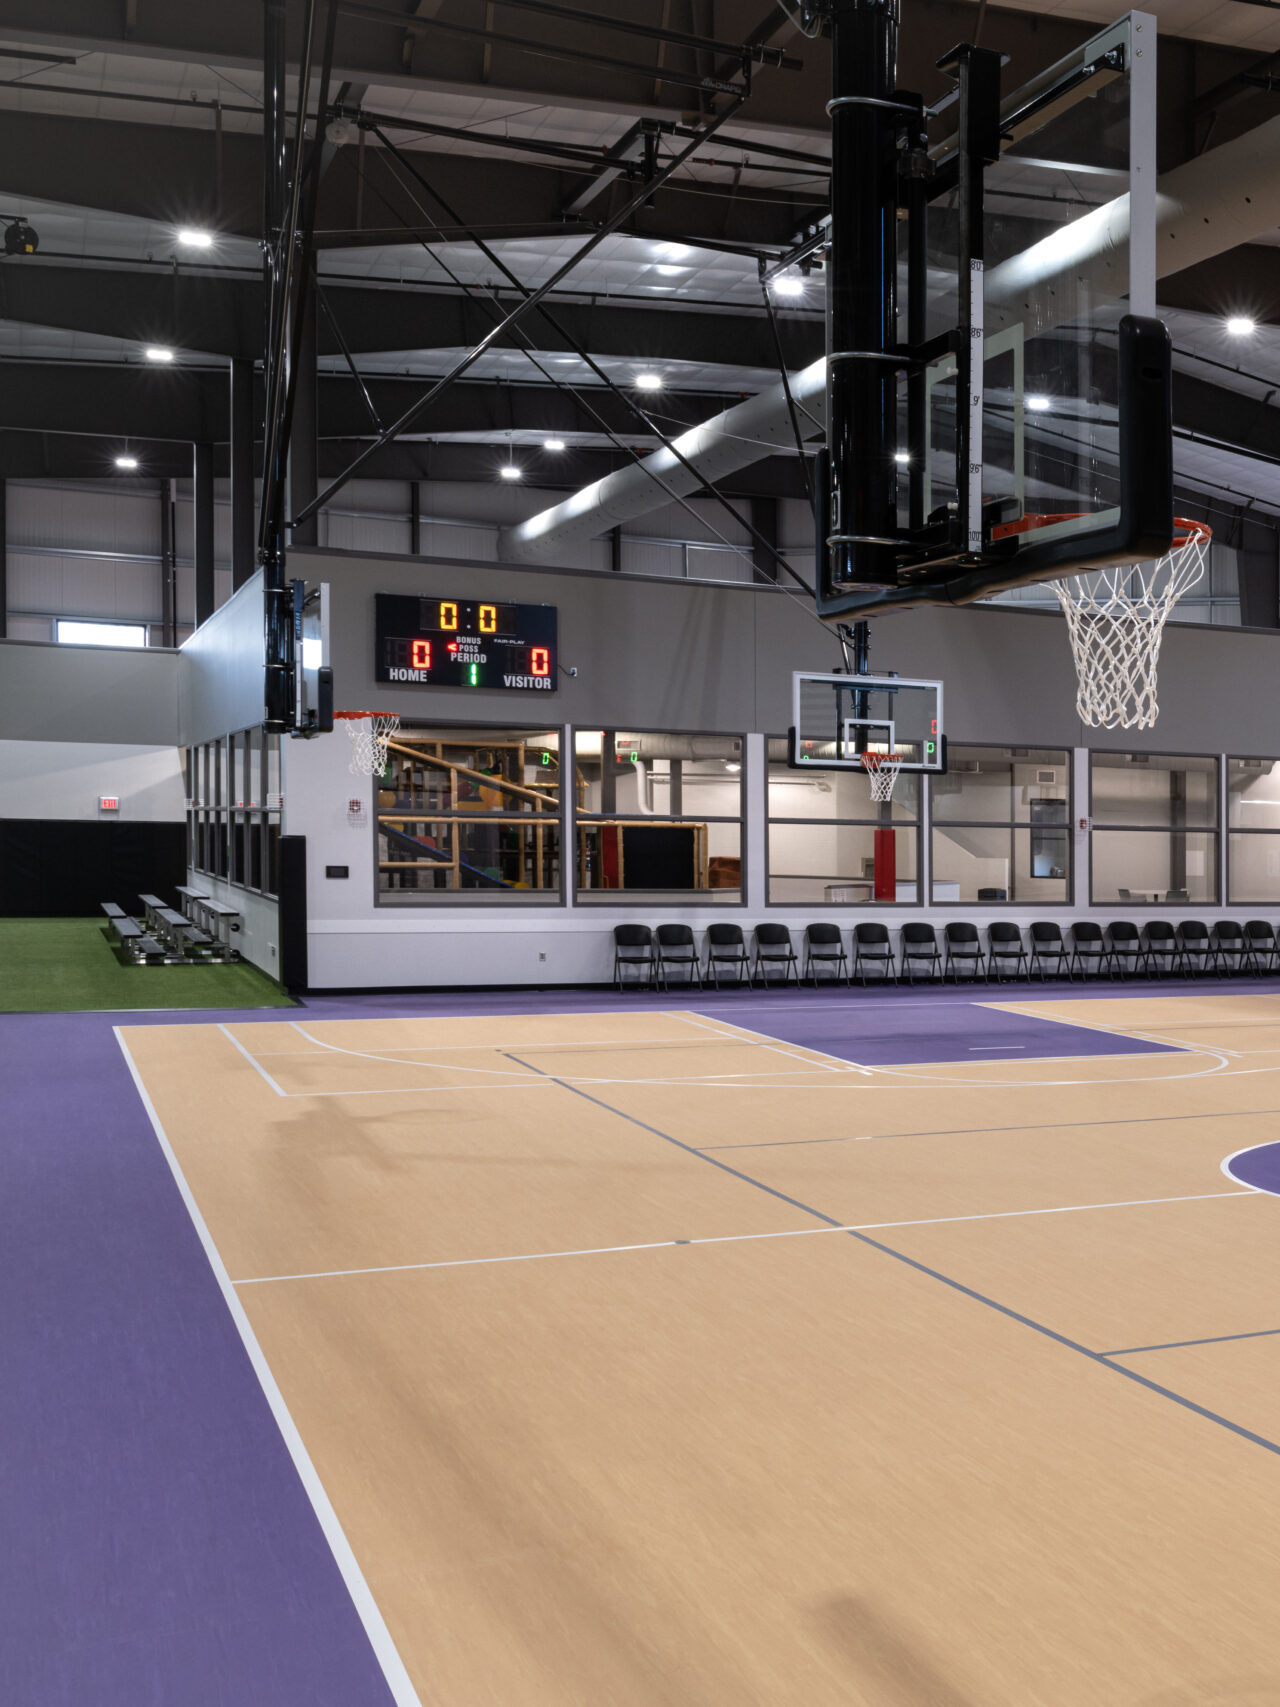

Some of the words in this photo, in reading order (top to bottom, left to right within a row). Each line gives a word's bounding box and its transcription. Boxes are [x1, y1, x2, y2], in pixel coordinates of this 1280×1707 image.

[456, 636, 482, 645] BONUS
[412, 640, 430, 668] 0
[459, 645, 479, 653] POSS
[531, 648, 549, 675] 0
[450, 652, 487, 664] PERIOD
[389, 668, 428, 682] HOME
[503, 674, 552, 690] VISITOR
